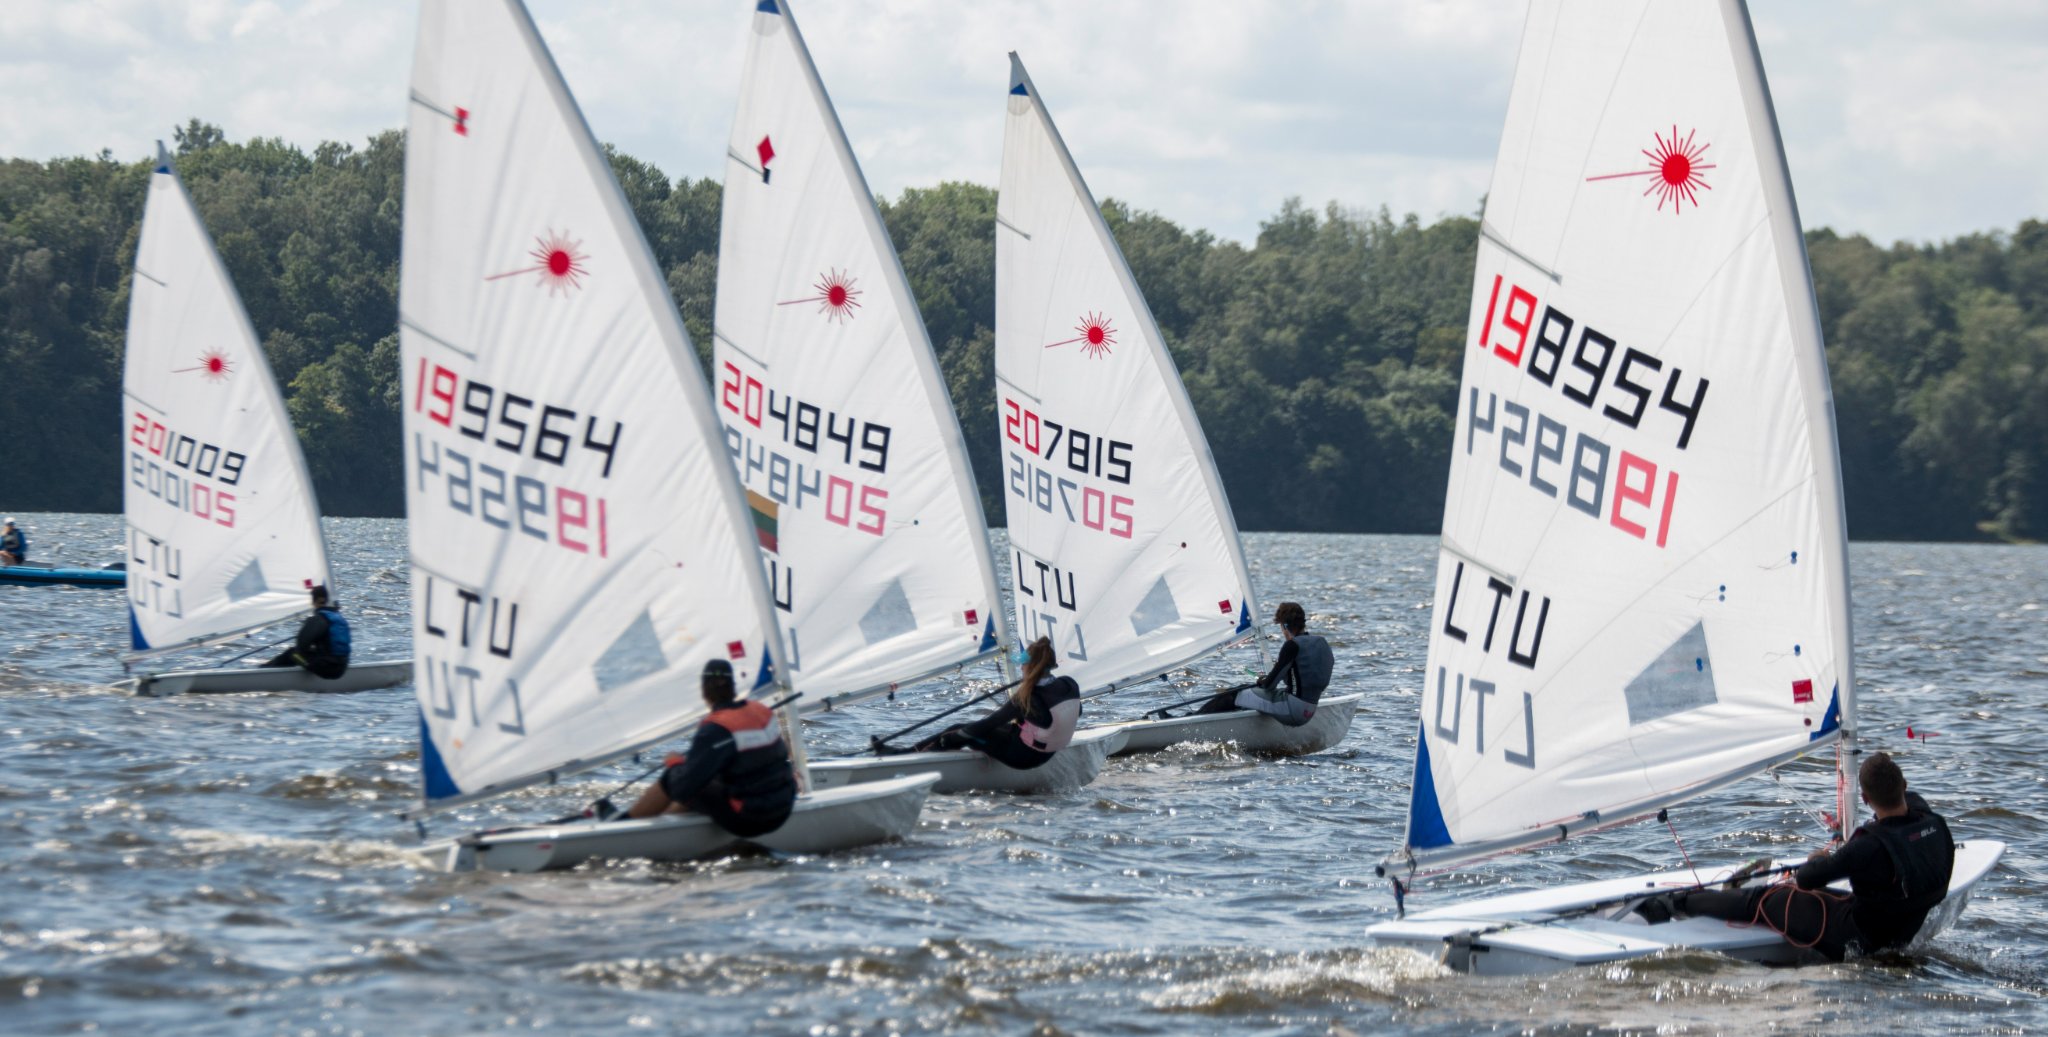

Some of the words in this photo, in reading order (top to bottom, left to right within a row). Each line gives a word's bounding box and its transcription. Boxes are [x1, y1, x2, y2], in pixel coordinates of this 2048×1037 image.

[1479, 273, 1710, 450] 198954
[131, 411, 247, 486] 201009
[415, 357, 623, 478] 199564
[723, 360, 891, 474] 204849
[1006, 397, 1133, 485] 207815
[132, 529, 180, 581] LTU
[1017, 551, 1077, 612] LTU
[426, 576, 518, 659] LTU
[1444, 561, 1551, 670] LTU
